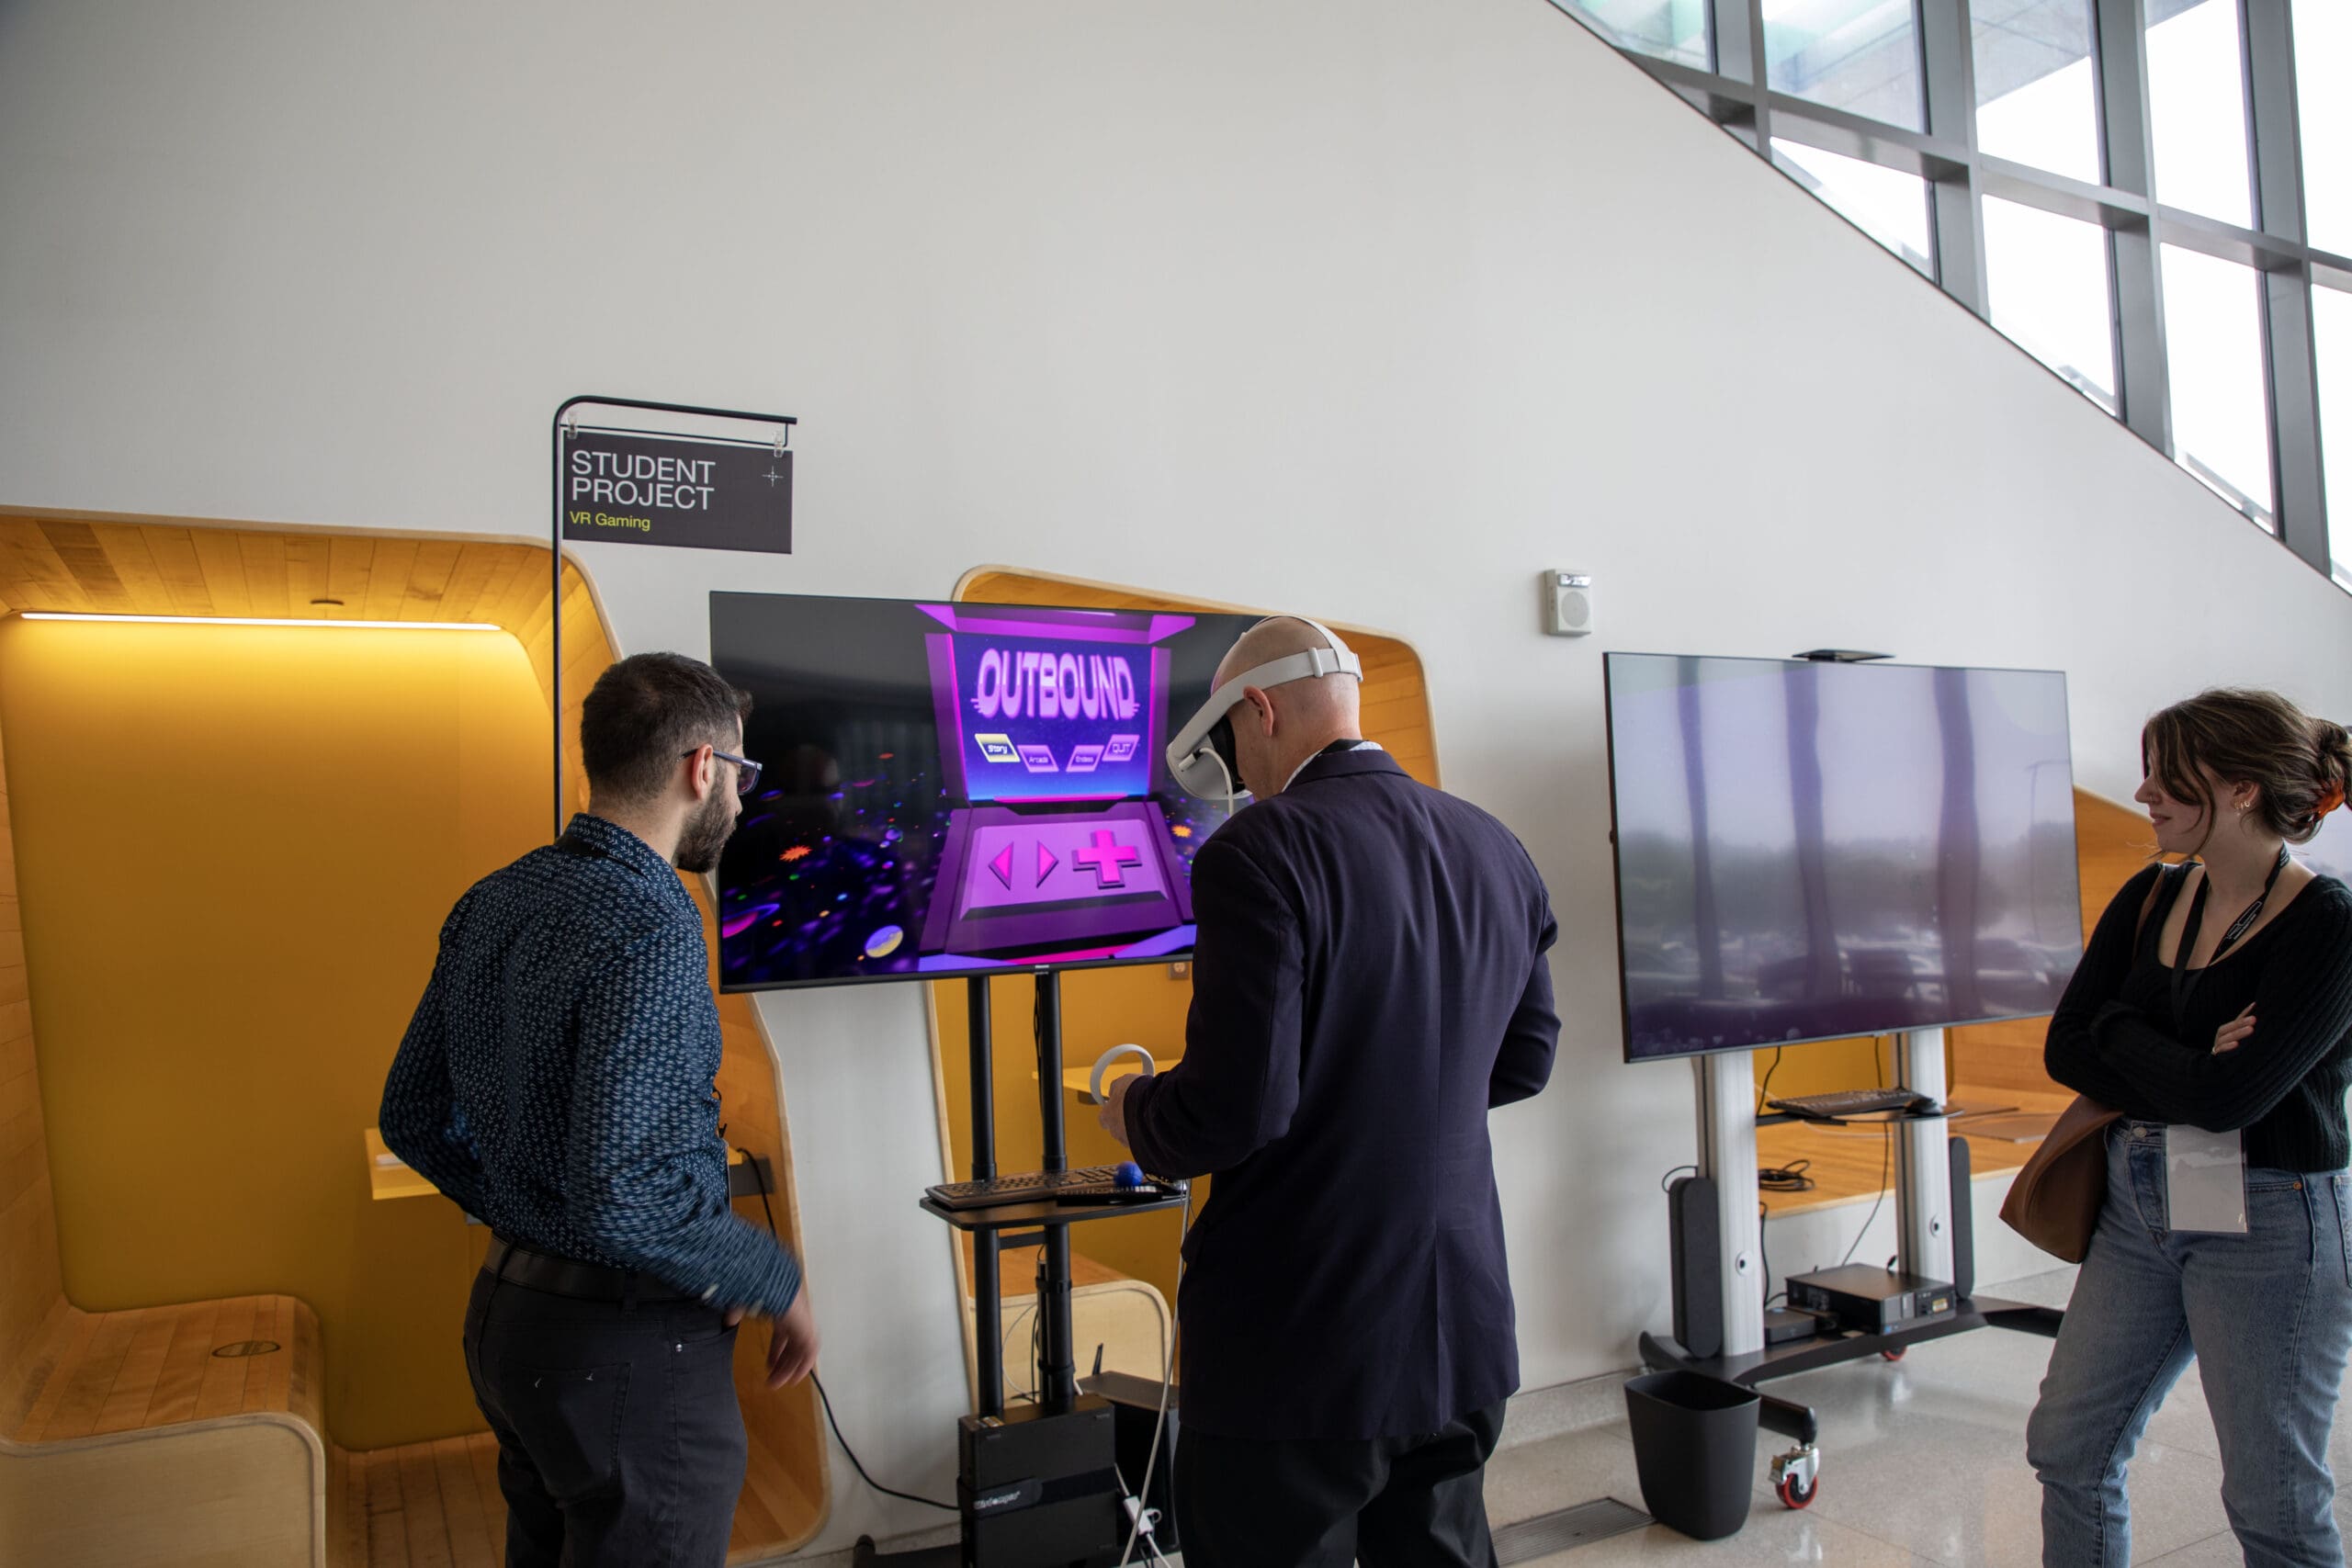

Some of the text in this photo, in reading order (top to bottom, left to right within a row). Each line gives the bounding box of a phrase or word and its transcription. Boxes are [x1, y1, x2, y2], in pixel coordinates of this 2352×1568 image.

[571, 450, 717, 485] STUDENT
[571, 477, 715, 511] PROJECT
[570, 511, 651, 532] VR Gaming
[971, 649, 1139, 720] OUTBOUND
[988, 745, 1008, 754] Story
